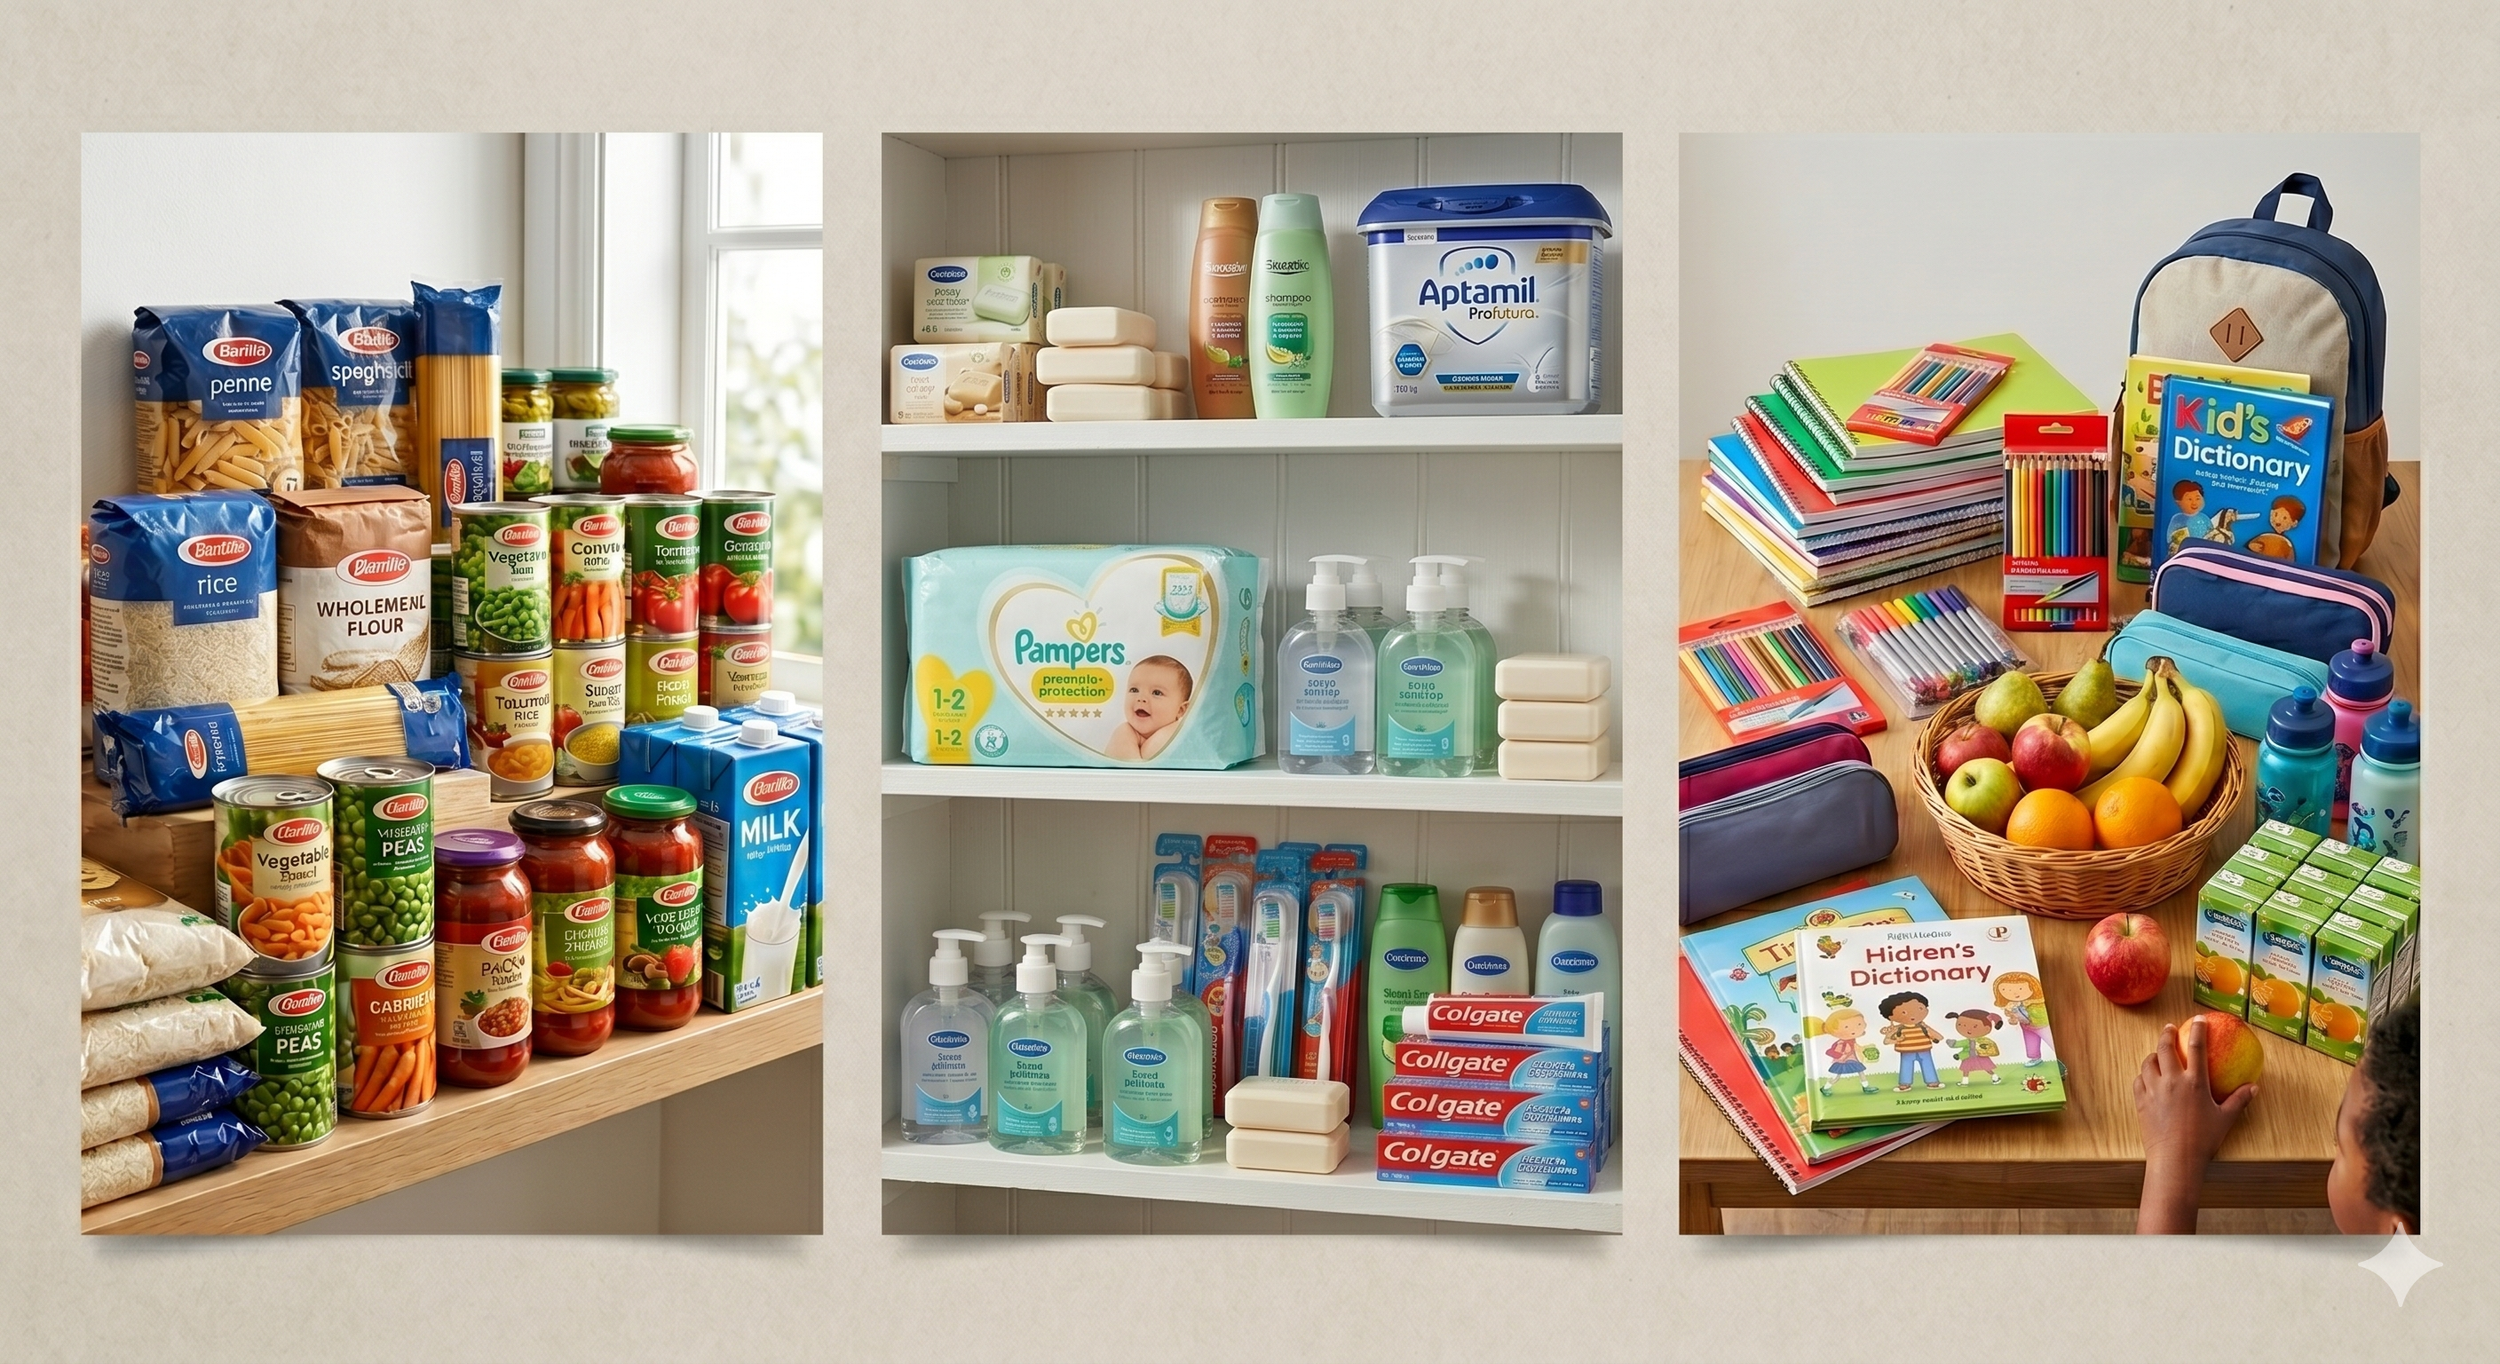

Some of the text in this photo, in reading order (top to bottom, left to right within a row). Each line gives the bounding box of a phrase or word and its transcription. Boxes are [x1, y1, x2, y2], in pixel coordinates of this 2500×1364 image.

[219, 344, 267, 359] Barilla
[210, 375, 273, 400] penne
[2175, 393, 2271, 443] Kid's
[2174, 435, 2311, 487] Dictionary
[197, 574, 238, 596] rice
[347, 617, 404, 637] FLOUR
[1014, 629, 1126, 671] Pampers
[933, 688, 965, 710] 1-2
[1039, 686, 1106, 698] protection
[514, 711, 540, 721] RICE
[935, 729, 962, 745] 1-2
[740, 808, 802, 849] MILK
[257, 845, 330, 870] Vegetable
[382, 836, 425, 858] PEAS
[1865, 943, 1976, 964] Hidren's
[1850, 965, 1992, 987] Dictionary
[1432, 1005, 1524, 1027] Colgate
[276, 1032, 322, 1055] PEAS
[1401, 1050, 1509, 1078] Collgate
[1390, 1091, 1502, 1122] Colgate
[1383, 1141, 1497, 1170] Colgate
